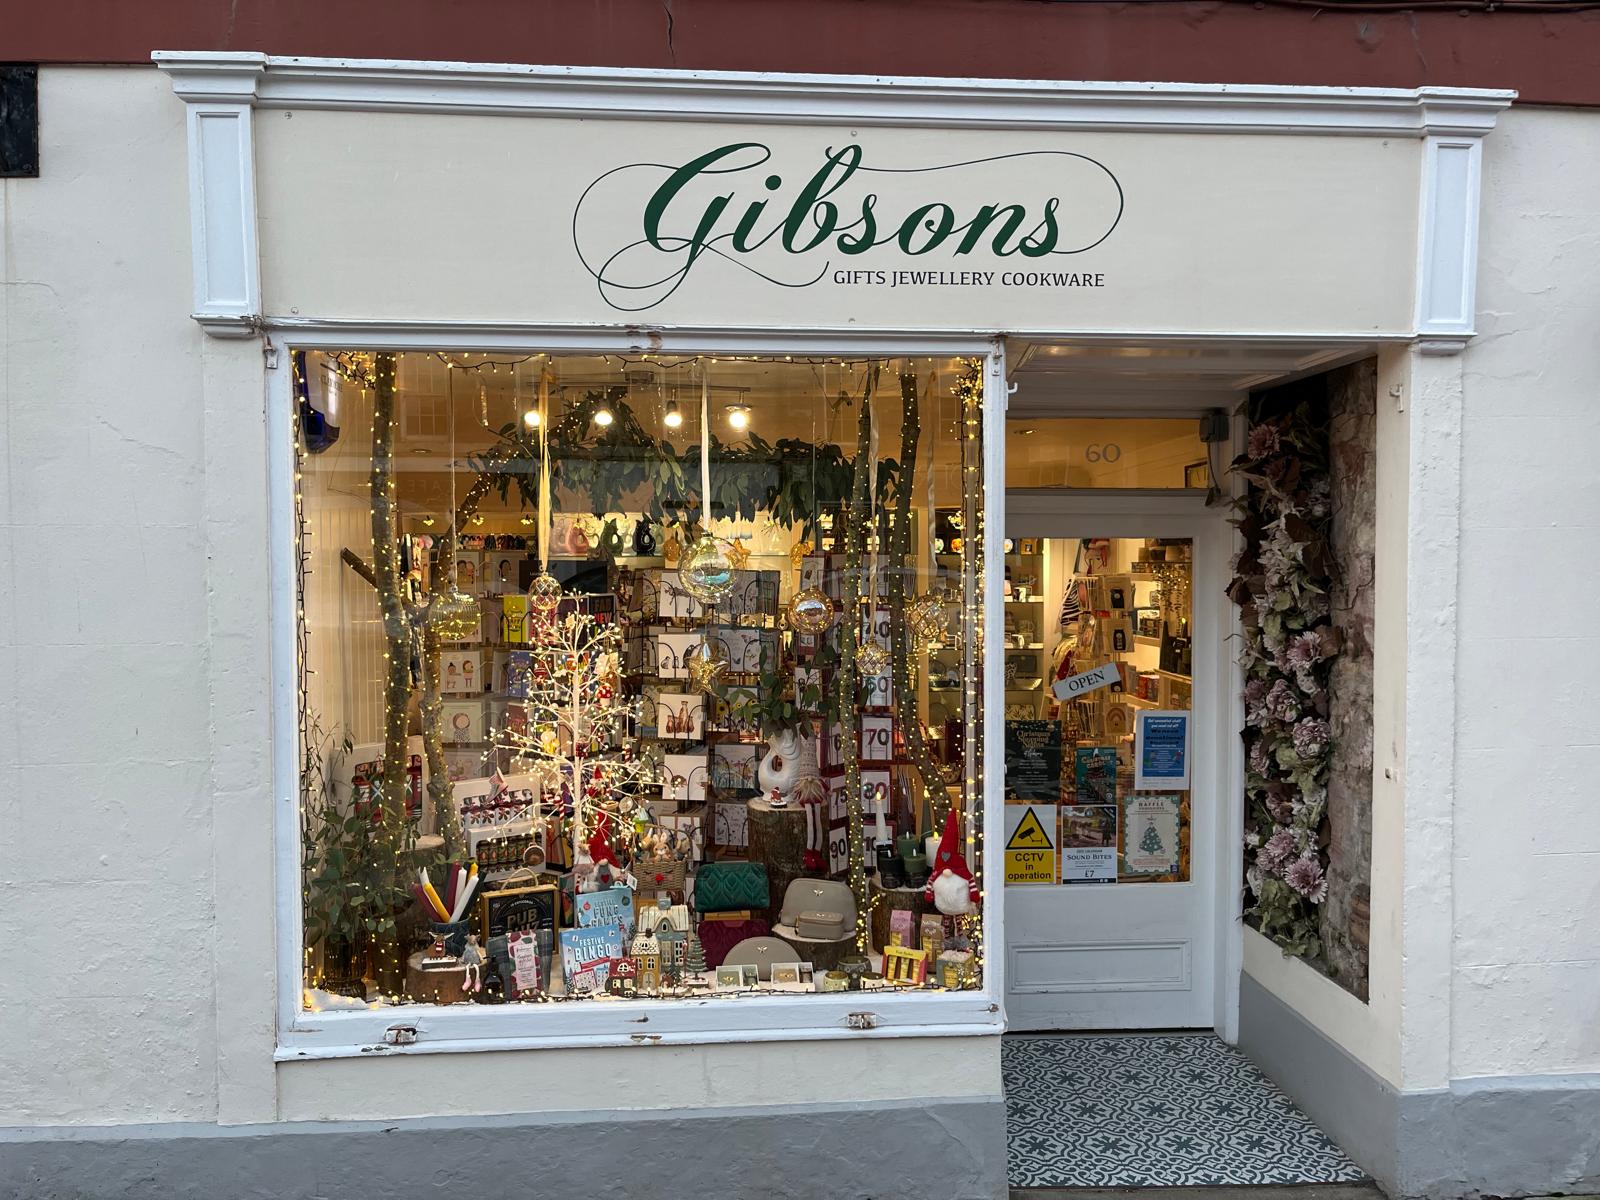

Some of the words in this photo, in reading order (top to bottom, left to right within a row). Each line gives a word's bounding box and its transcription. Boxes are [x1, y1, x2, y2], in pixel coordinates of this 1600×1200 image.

[573, 142, 1123, 310] Gibsons
[834, 271, 886, 287] GIFTS
[891, 271, 994, 288] JEWELLERY
[1001, 273, 1105, 288] COOKWARE
[1086, 443, 1121, 464] 60
[1068, 670, 1105, 692] OPEN
[865, 728, 890, 746] 70
[833, 787, 848, 805] 75
[864, 782, 888, 800] 80
[830, 839, 847, 859] 90
[1015, 853, 1044, 862] CCTV
[1025, 863, 1034, 871] in
[1084, 869, 1095, 878] £7
[1008, 872, 1051, 881] operation
[507, 908, 538, 929] PUB
[580, 936, 606, 948] FESTIVE
[575, 943, 612, 962] BINGO
